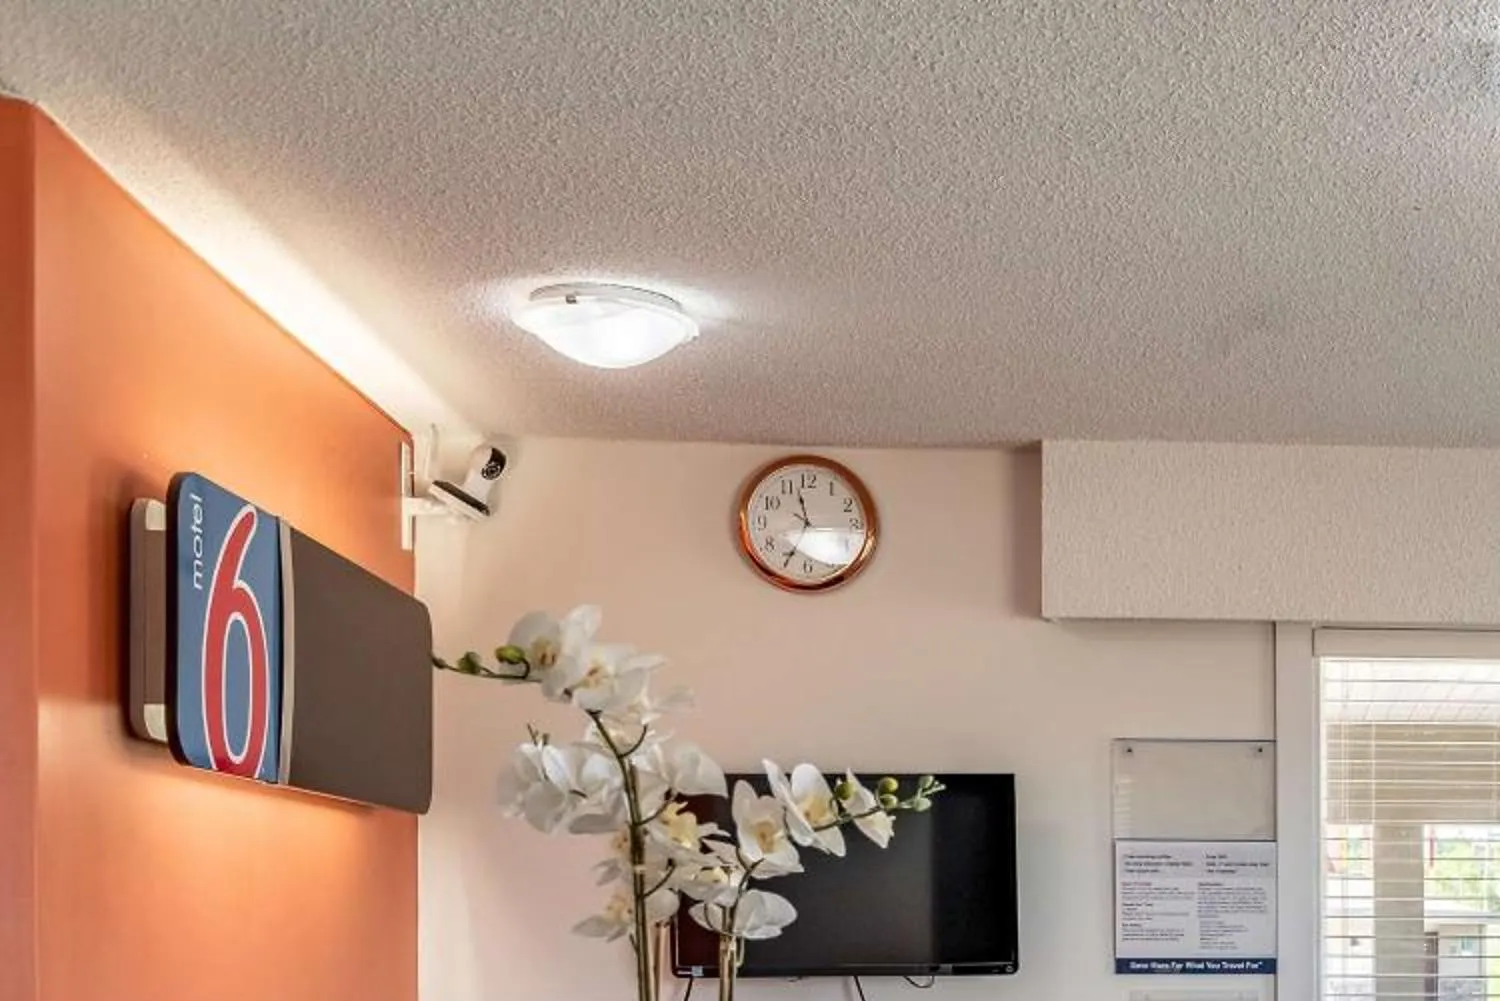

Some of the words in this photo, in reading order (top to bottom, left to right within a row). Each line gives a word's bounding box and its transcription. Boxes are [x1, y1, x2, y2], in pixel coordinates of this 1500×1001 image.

[781, 479, 793, 495] 11
[800, 473, 817, 489] 12
[829, 481, 835, 497] 1
[764, 495, 781, 511] 10
[843, 498, 853, 513] 2
[757, 515, 767, 531] 9
[188, 491, 204, 591] motel
[765, 536, 775, 552] 8
[803, 559, 813, 574] 6
[201, 502, 271, 779] 6
